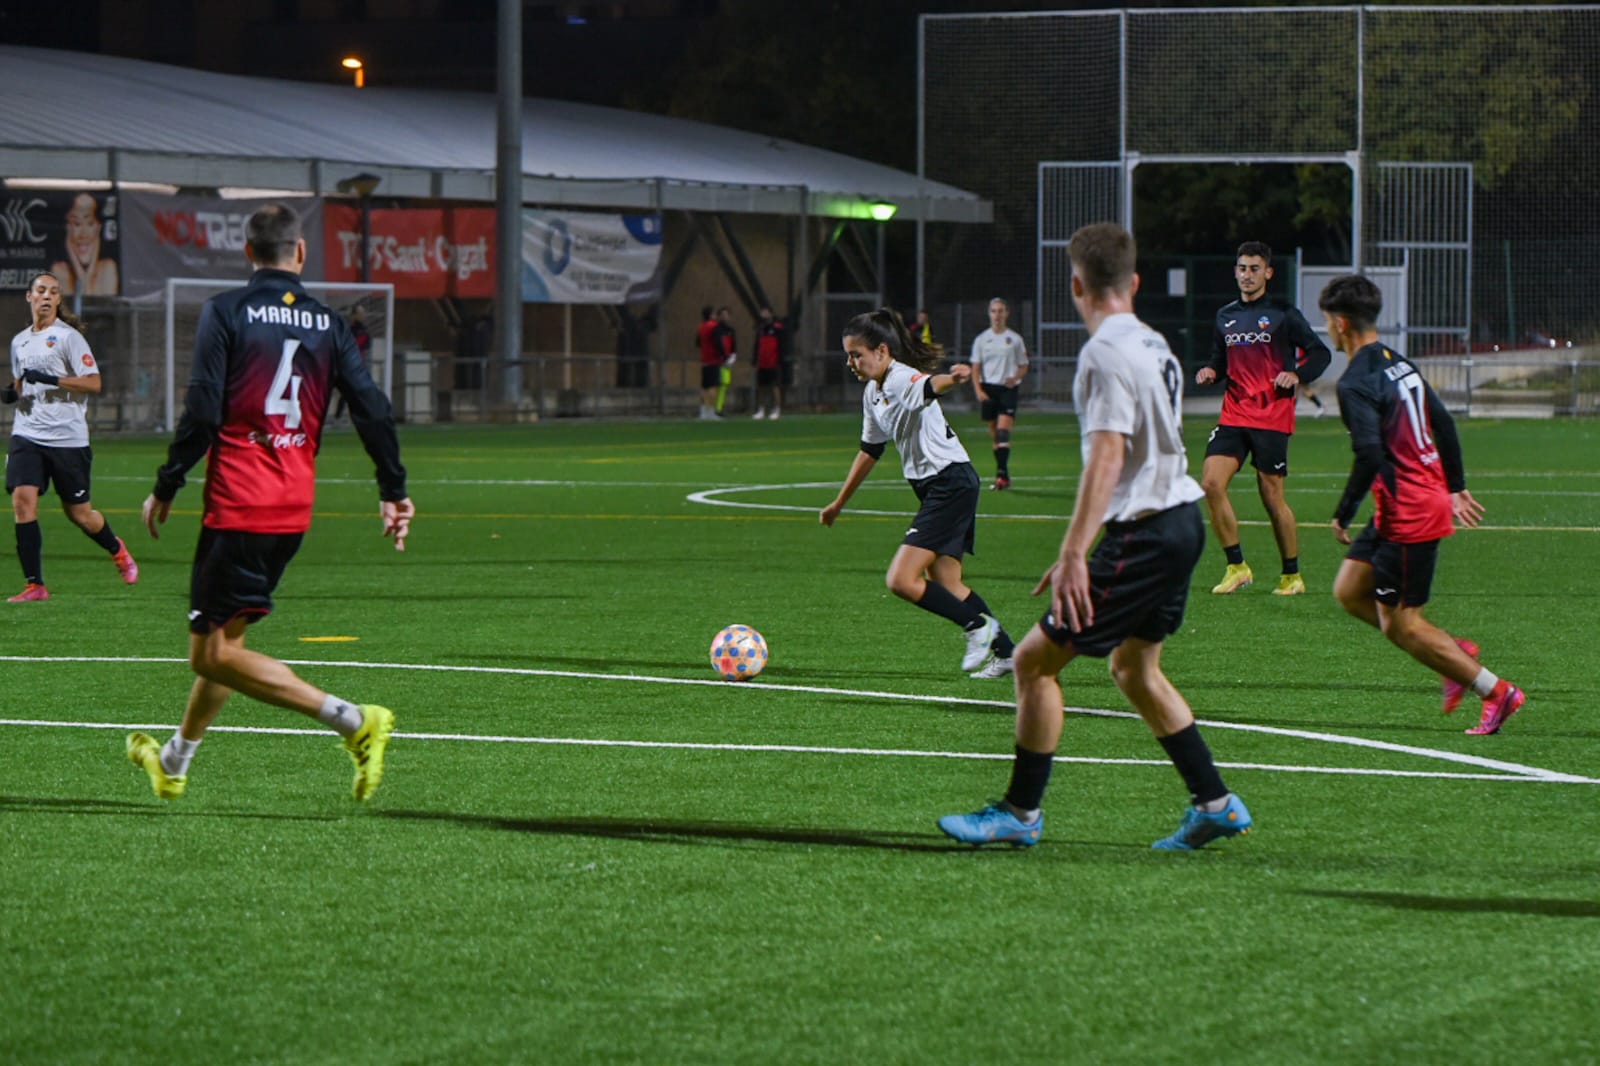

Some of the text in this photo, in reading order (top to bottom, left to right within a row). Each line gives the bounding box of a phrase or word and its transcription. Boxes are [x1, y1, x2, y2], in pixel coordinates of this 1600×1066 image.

[246, 304, 313, 330] MARIO
[264, 338, 303, 429] 4
[1397, 372, 1433, 450] 17
